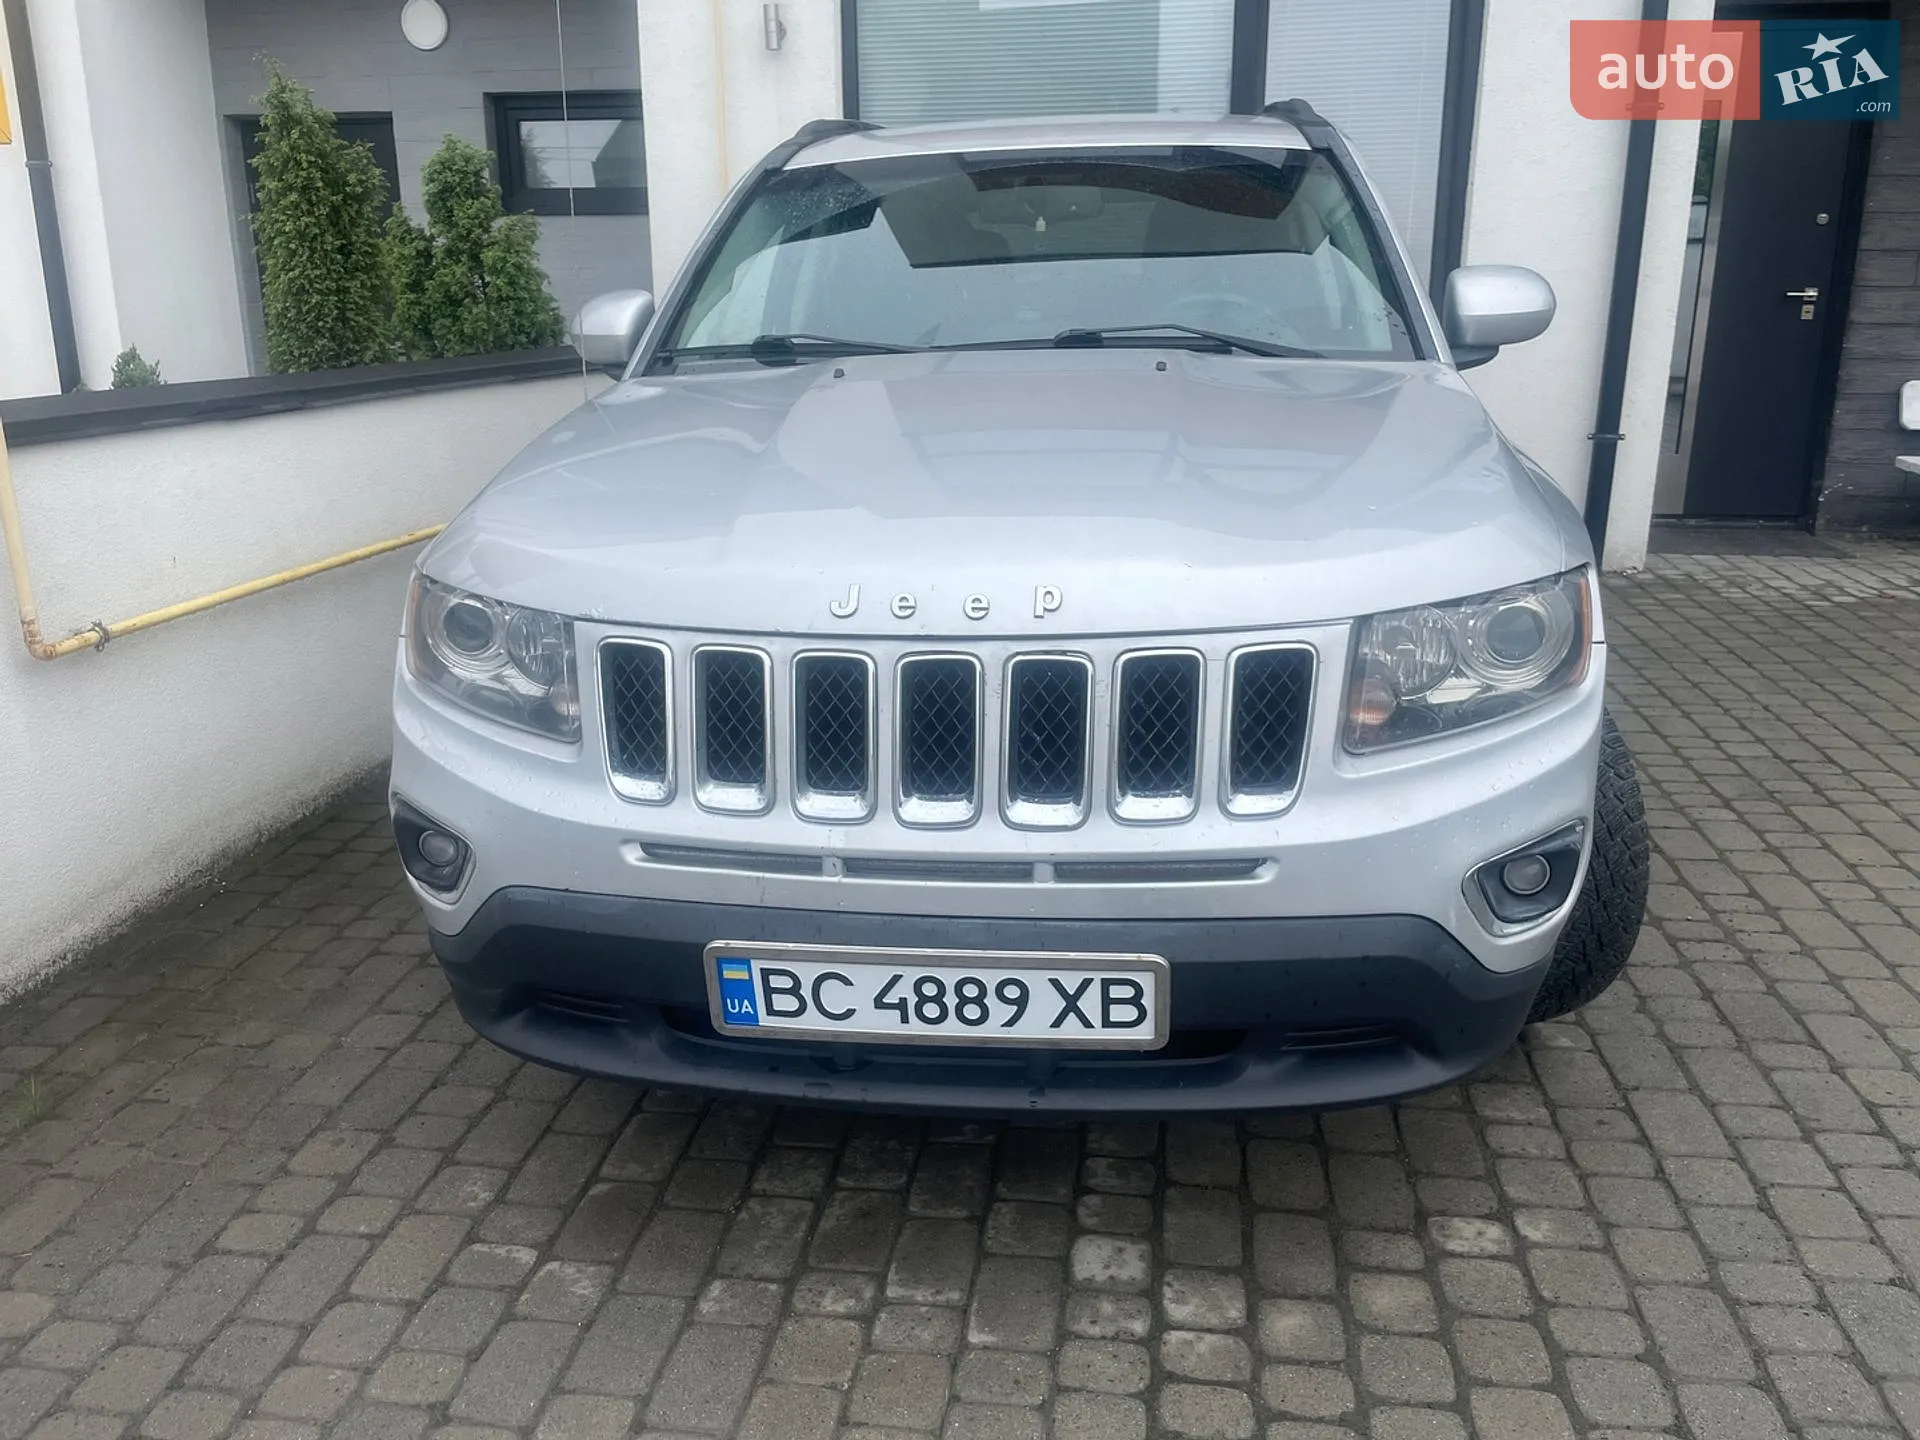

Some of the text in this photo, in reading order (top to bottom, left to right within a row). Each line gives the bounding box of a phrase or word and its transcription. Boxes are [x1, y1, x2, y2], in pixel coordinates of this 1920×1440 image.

[829, 583, 1063, 620] Jeep
[726, 998, 754, 1015] UA
[760, 967, 1148, 1029] BC 4889 XB
